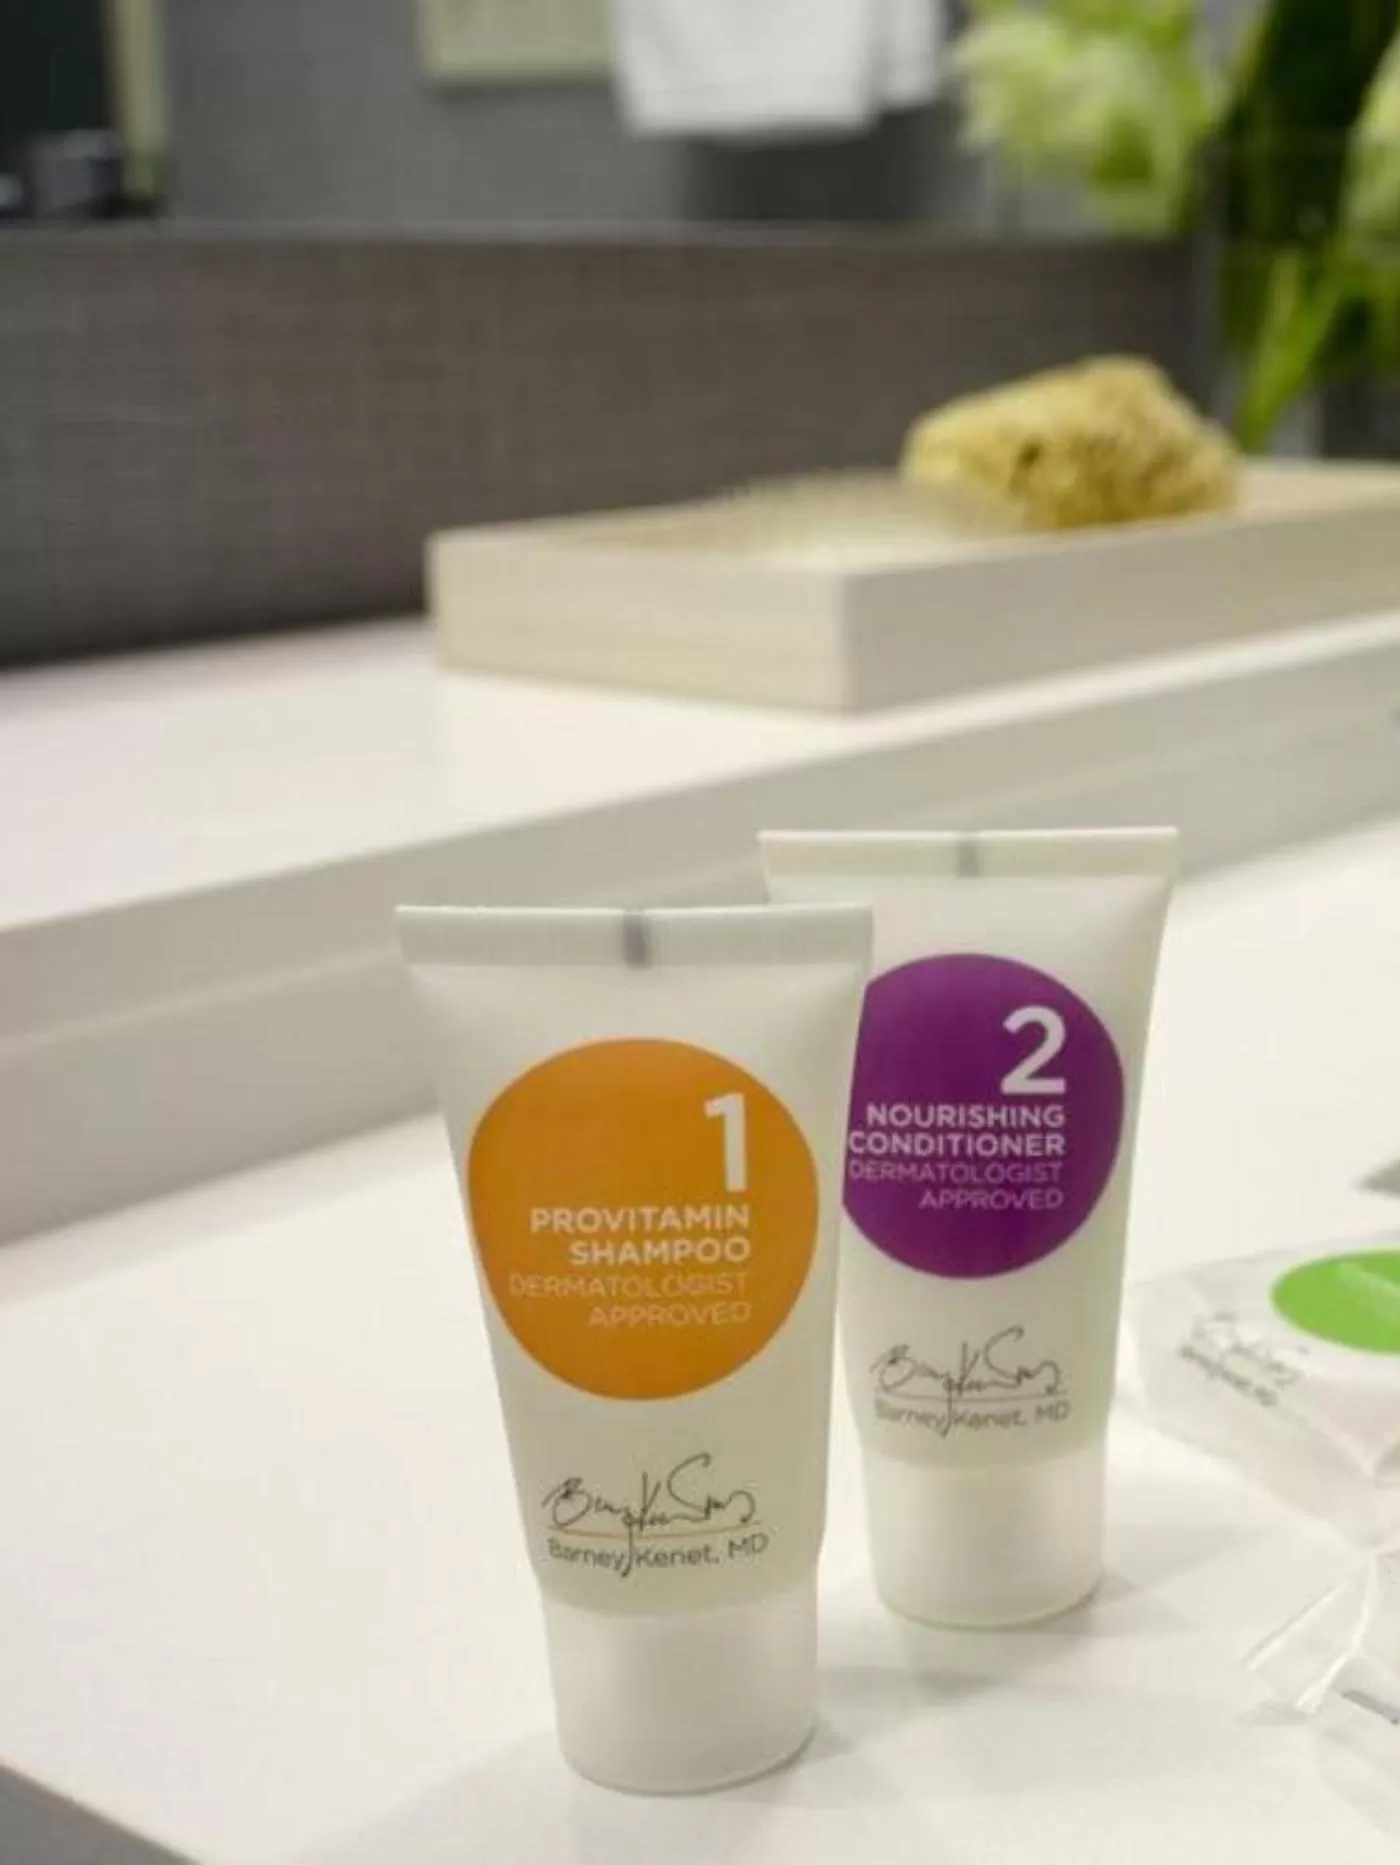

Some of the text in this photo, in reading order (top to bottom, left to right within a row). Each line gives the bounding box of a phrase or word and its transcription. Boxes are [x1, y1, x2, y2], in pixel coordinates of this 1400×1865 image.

[1001, 1005, 1066, 1094] 2
[866, 1103, 1066, 1129] NOURISHING
[704, 1092, 748, 1193] 1
[849, 1130, 1066, 1157] CONDITIONER
[849, 1160, 1063, 1185] DERMATOLOGIST
[918, 1187, 1064, 1211] APPROVED
[529, 1204, 751, 1235] PROVITAMIN
[568, 1237, 752, 1266] SHAMPOO
[508, 1271, 749, 1299] DERMATOLOGIST
[587, 1300, 752, 1328] APPROVED
[728, 1531, 770, 1558] MD
